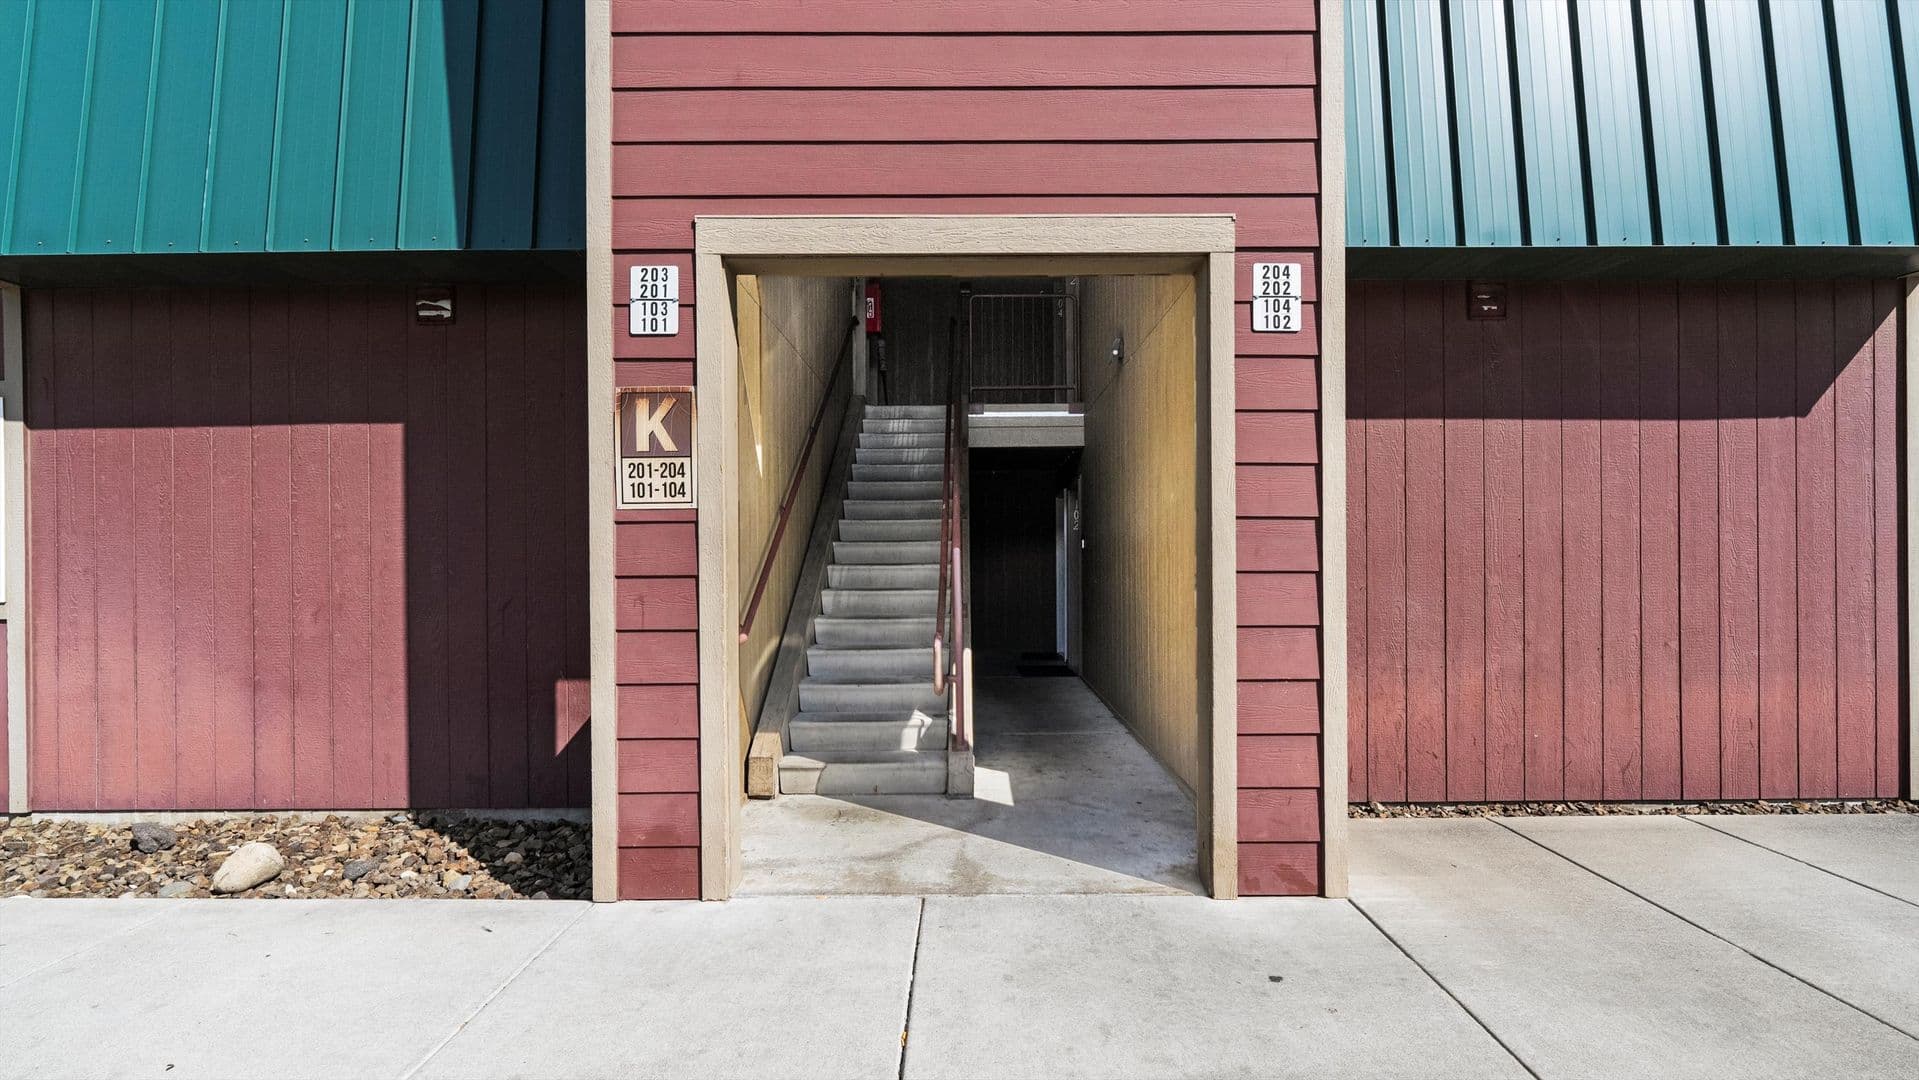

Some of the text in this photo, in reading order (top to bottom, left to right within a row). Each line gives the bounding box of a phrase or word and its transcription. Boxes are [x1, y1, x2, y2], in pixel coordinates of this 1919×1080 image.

[640, 267, 668, 282] 203
[1262, 265, 1290, 279] 204
[640, 284, 667, 298] 201
[1262, 281, 1291, 295] 202
[641, 302, 668, 316] 103
[1264, 298, 1291, 313] 104
[641, 318, 667, 332] 101
[1264, 314, 1291, 329] 102
[635, 397, 678, 452] K
[628, 462, 685, 479] 201-204
[630, 482, 686, 498] 101-104
